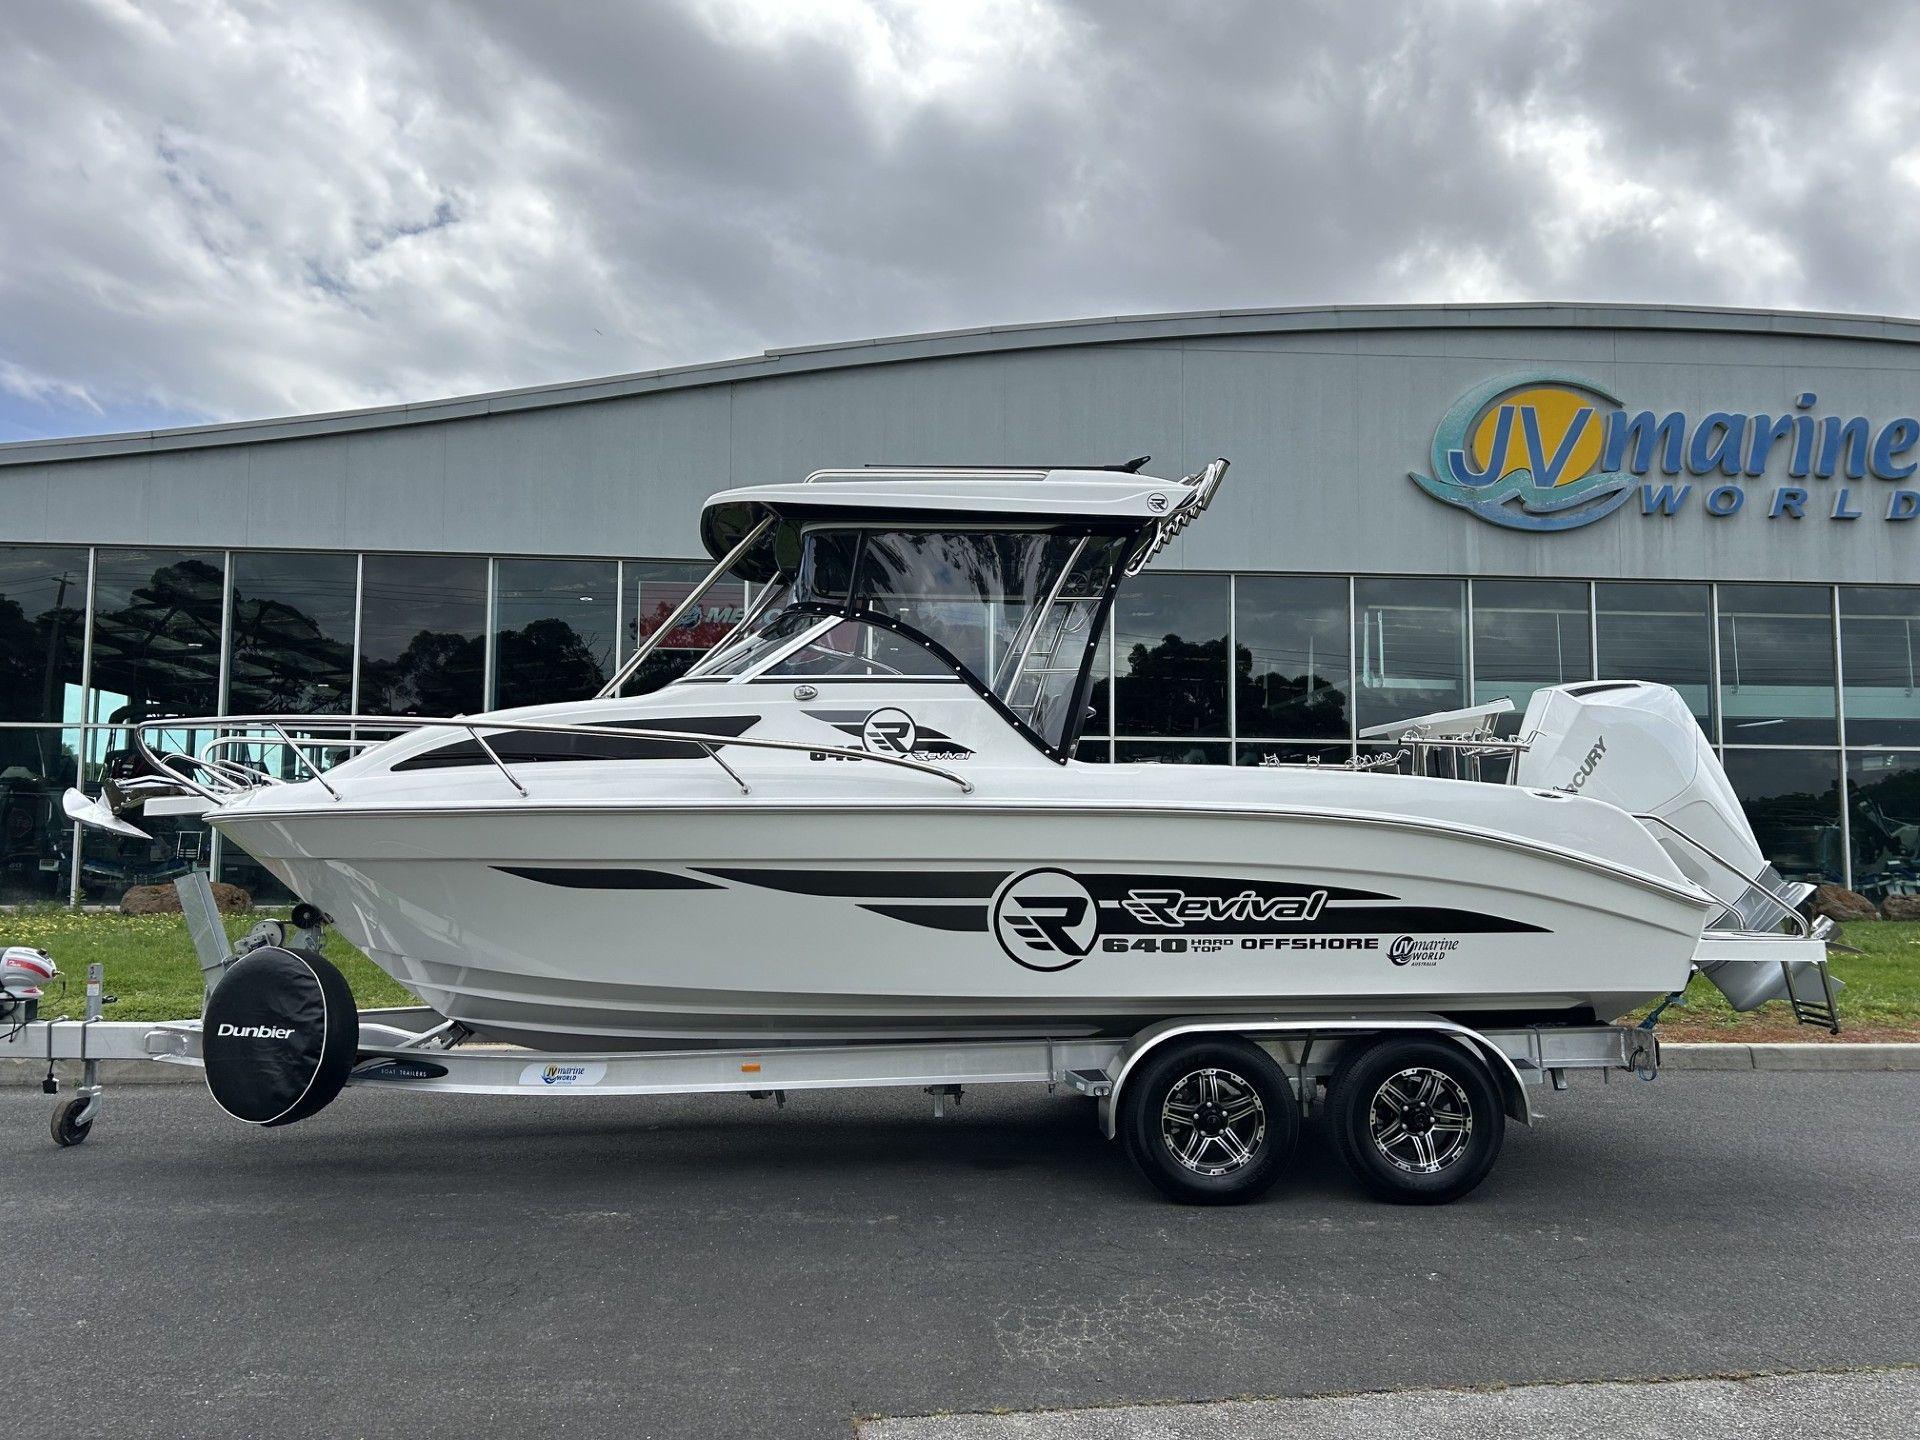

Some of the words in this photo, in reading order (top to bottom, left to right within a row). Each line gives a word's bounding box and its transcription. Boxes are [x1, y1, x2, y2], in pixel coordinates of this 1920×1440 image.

[1447, 404, 1595, 490] JV
[1602, 392, 1919, 481] marine
[1640, 484, 1920, 521] WORLD
[912, 750, 971, 762] Revival
[1121, 889, 1328, 927] Revival
[1102, 938, 1188, 953] 640
[1191, 938, 1234, 946] HARD
[1240, 938, 1379, 950] OFFSHORE
[1413, 937, 1459, 950] marine
[1412, 951, 1446, 961] WORLD
[217, 1023, 296, 1039] Dunbier
[557, 1066, 585, 1075] marine
